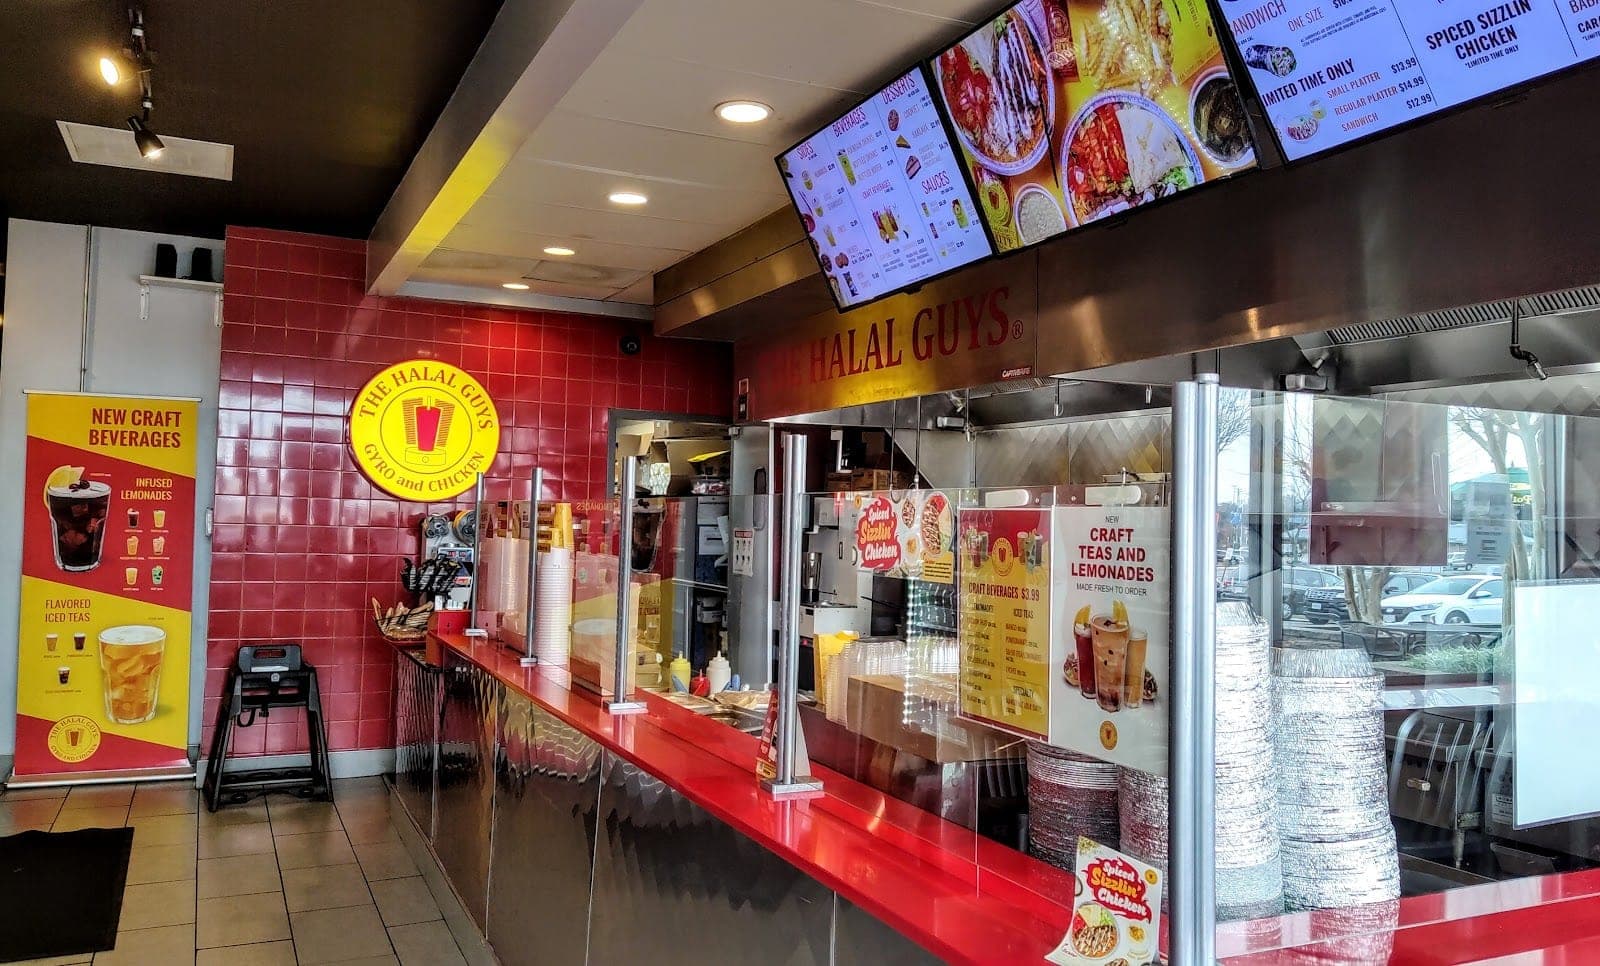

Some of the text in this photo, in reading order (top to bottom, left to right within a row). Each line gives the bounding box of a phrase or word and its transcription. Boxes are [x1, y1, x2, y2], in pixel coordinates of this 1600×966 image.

[1231, 0, 1287, 35] ANDWICH
[1288, 16, 1306, 32] ONE
[1304, 6, 1325, 24] SIZE
[1426, 0, 1532, 50] SPICED SIZZLIN
[1578, 16, 1600, 33] CAR
[1455, 24, 1518, 60] CHICKEN
[1490, 50, 1505, 63] TIME
[1505, 44, 1519, 55] ONLY
[881, 72, 915, 104] DESSERTS
[1260, 58, 1355, 108] IMITED TIME ONLY
[1327, 57, 1417, 99] SMALL PLATTER $13.99
[1334, 75, 1425, 116] REGULAR PLATTER $14.99
[832, 106, 867, 138] BEVERAGES
[1341, 93, 1432, 132] SANDWICH $12.99
[921, 170, 950, 195] SAUCES
[809, 318, 903, 384] HALAL
[359, 366, 494, 431] THE HALAL GUYS
[92, 407, 182, 428] NEW CRAFT
[89, 429, 182, 448] BEVERAGES
[364, 443, 485, 492] GYRO and CHICKEN
[136, 477, 173, 488] INFUSED
[121, 490, 173, 501] LEMONADES
[868, 506, 890, 523] Spiced
[1105, 515, 1119, 523] NEW
[860, 519, 894, 544] Sizzlin'
[1090, 527, 1134, 542] CRAFT
[864, 543, 898, 560] Chicken
[1079, 545, 1146, 562] TEAS AND
[1071, 563, 1154, 582] LEMONADES
[968, 582, 1040, 601] CRAFT BEVERAGES $3.99
[1077, 582, 1147, 596] MADE FRESH TO ORDER
[45, 599, 91, 609] FLAVORED
[1023, 609, 1034, 619] TEAS
[45, 612, 91, 623] ICED TEAS
[1103, 861, 1135, 881] Spiced
[1091, 867, 1141, 898] Sizzlin'
[1098, 888, 1147, 916] Chicken
